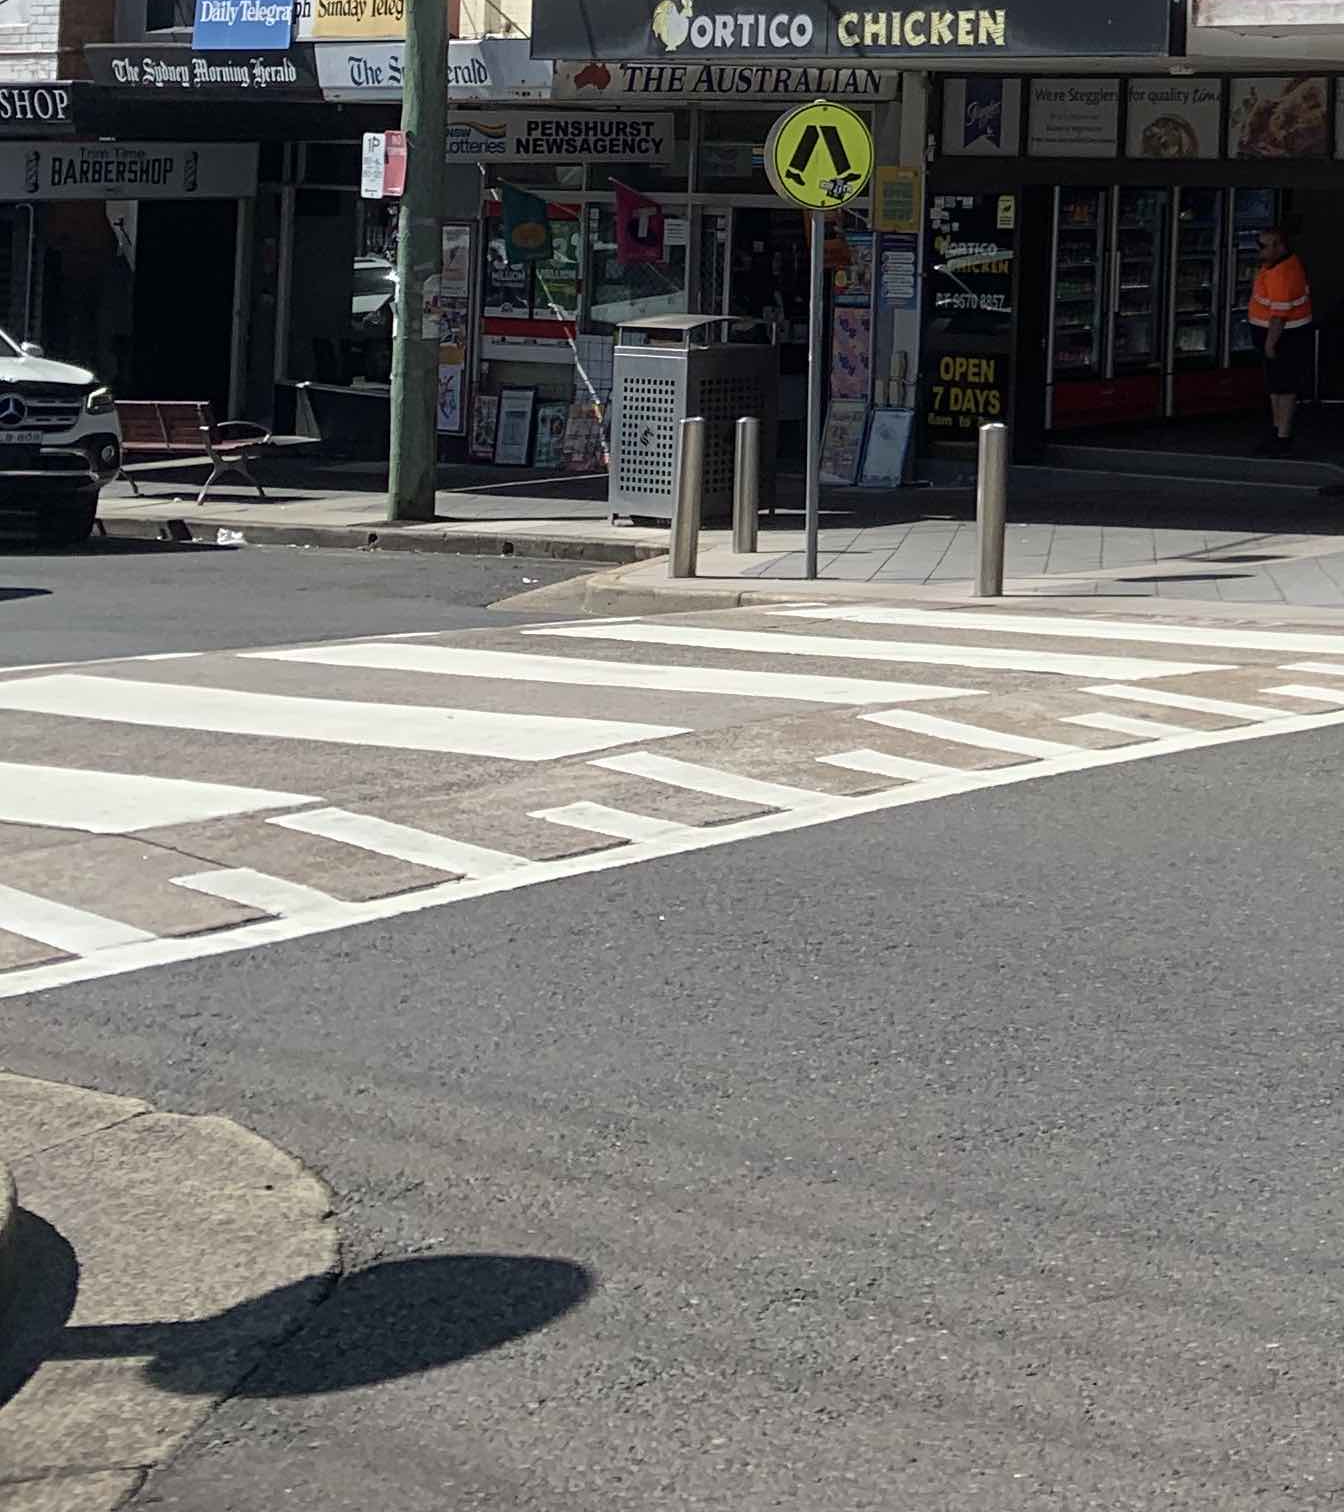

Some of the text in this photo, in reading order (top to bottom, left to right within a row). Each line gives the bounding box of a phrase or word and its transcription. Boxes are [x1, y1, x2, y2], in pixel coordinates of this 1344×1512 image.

[200, 0, 239, 26] Daily
[838, 8, 1006, 47] CHICKEN
[112, 57, 296, 88] The Sydney Morning Herald
[348, 56, 383, 86] The
[448, 57, 487, 84] erald
[624, 63, 881, 94] THE AUSTRALIAN
[0, 89, 68, 119] SHOP
[527, 121, 654, 137] PENSHURST
[449, 139, 505, 154] otteries
[516, 138, 663, 155] NEWSAGENCY
[51, 157, 174, 187] BARBERSHOP
[939, 356, 996, 383] OPEN
[932, 386, 1000, 415] 7 DAYS
